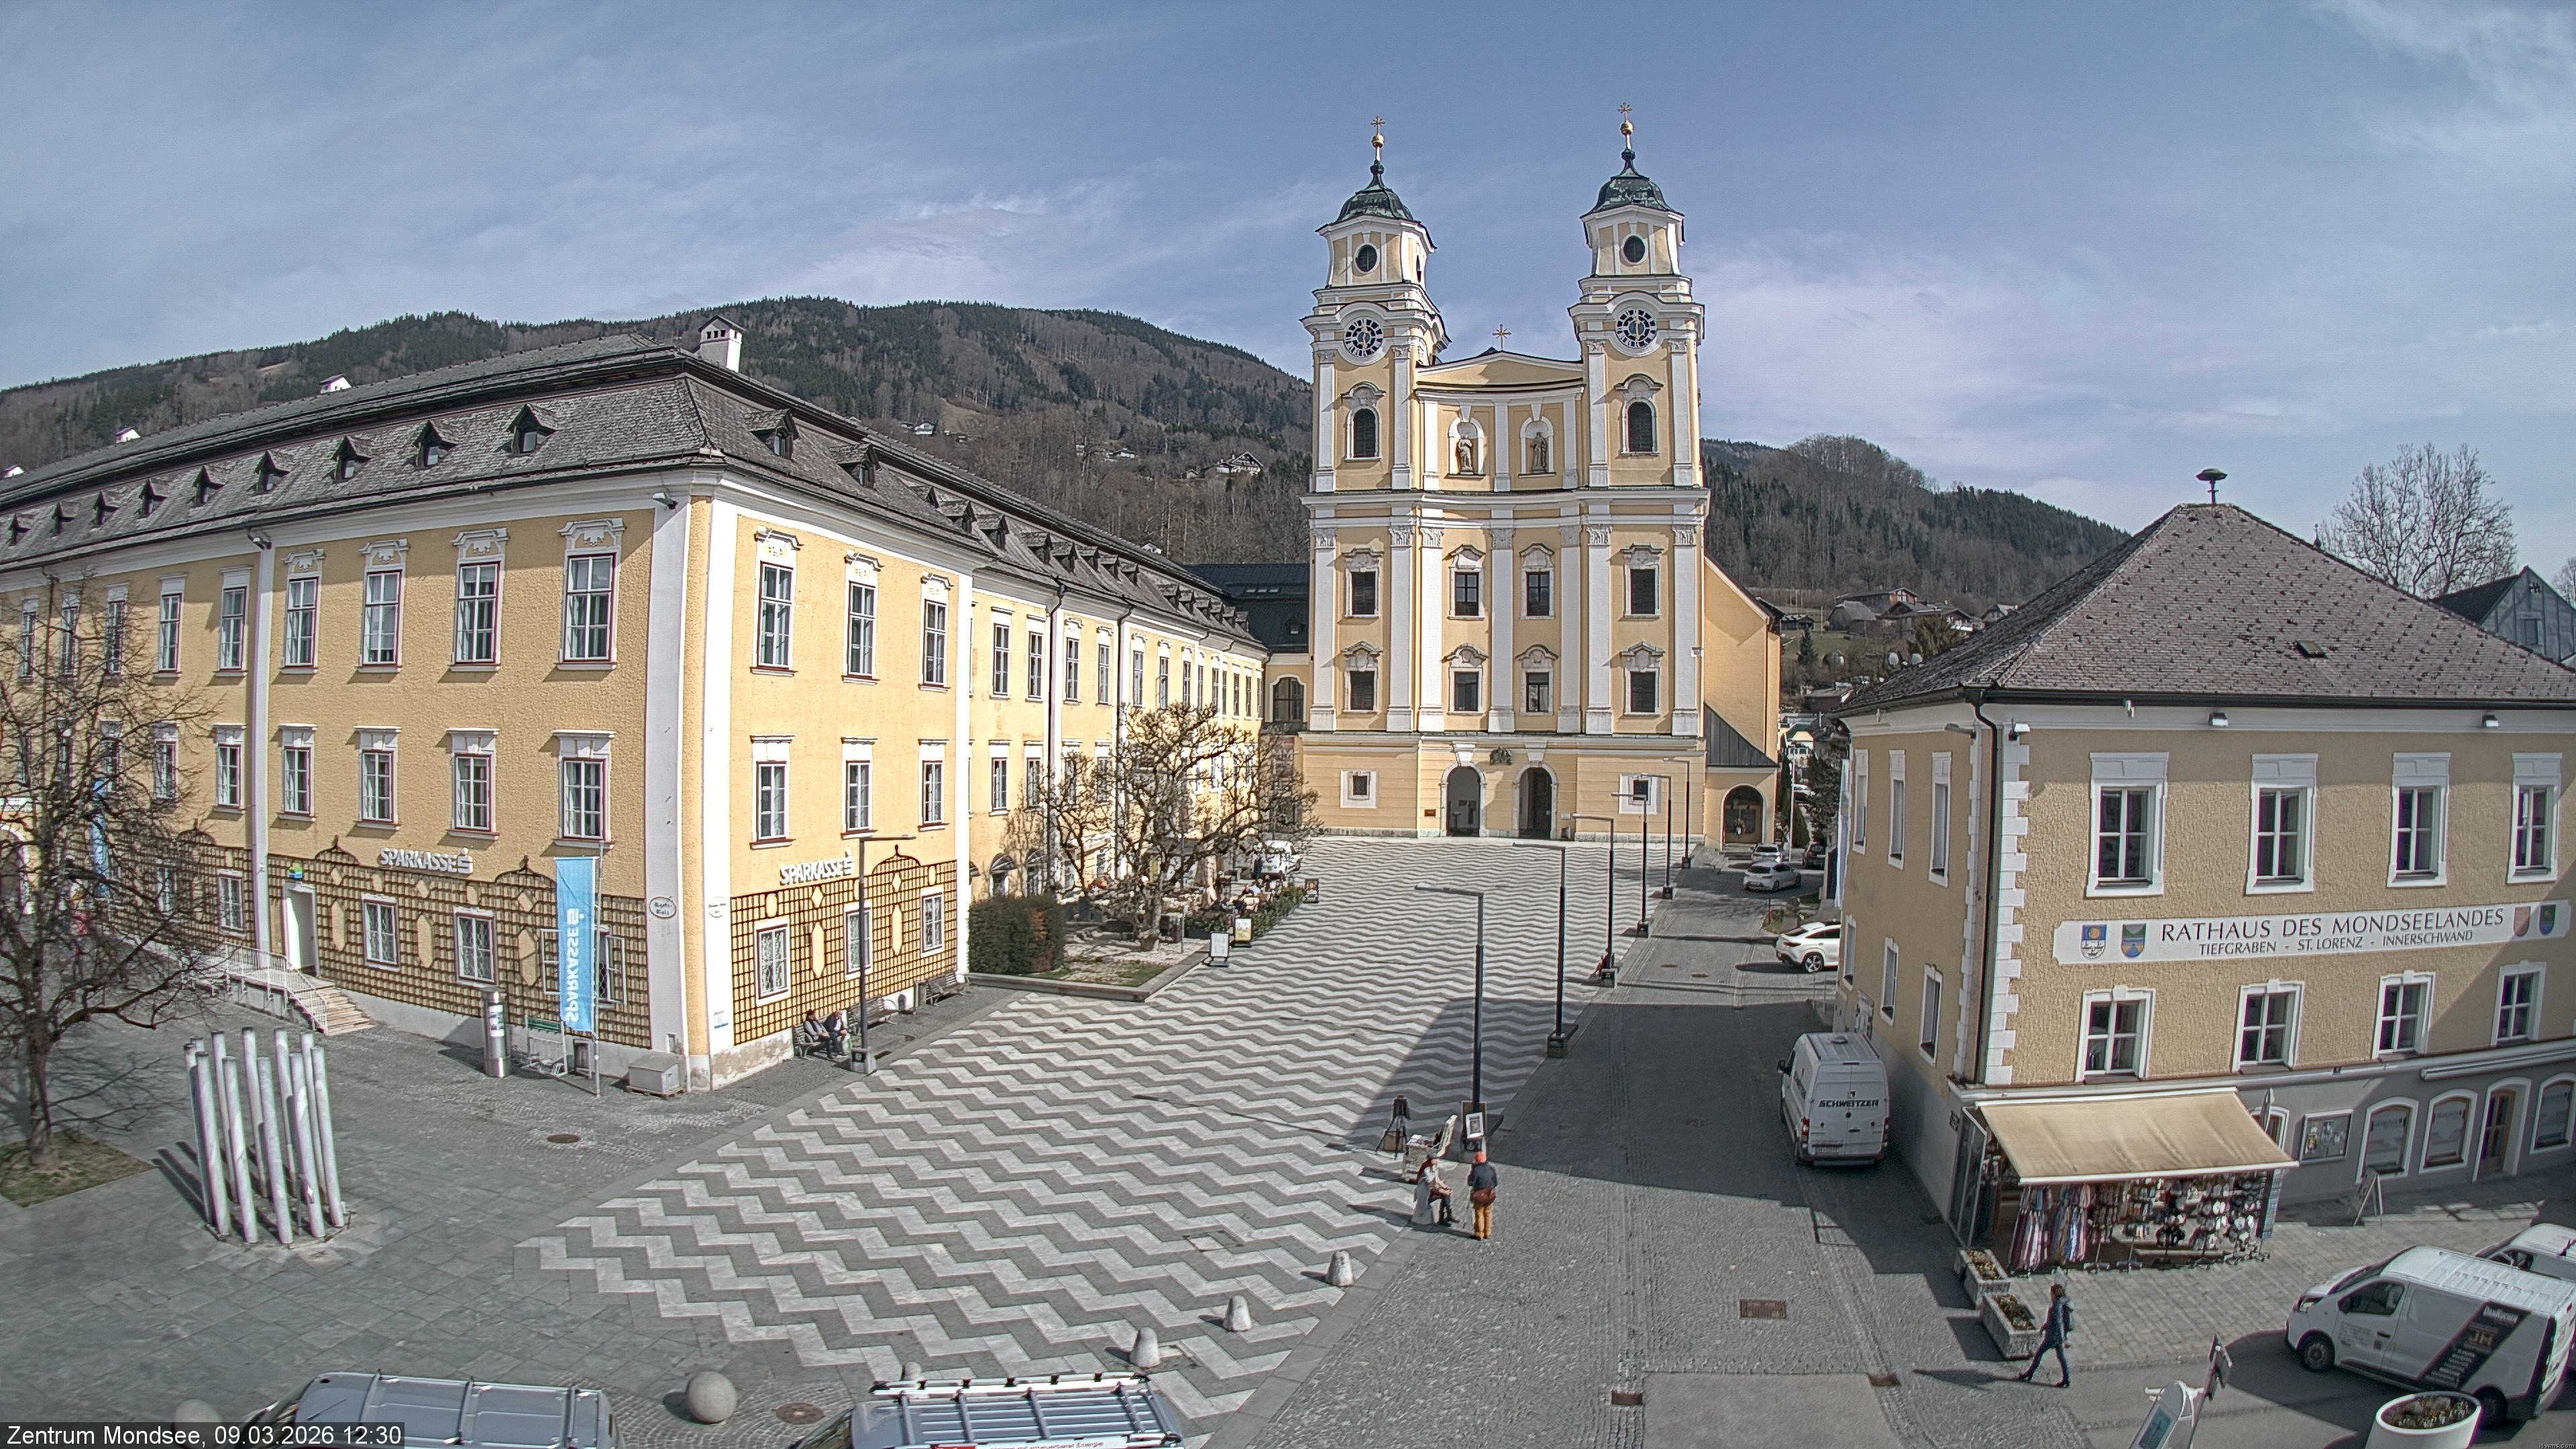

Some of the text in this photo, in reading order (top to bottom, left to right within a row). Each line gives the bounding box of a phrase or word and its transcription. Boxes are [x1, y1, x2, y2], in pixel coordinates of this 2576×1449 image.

[380, 847, 458, 873] SPARKASSE
[780, 858, 844, 884] SPARKASSE
[2161, 908, 2504, 942] RATHAUS DES MONDSEELANDES
[2199, 941, 2277, 955] TIEFGRABEN
[2297, 938, 2313, 951] ST.
[2316, 936, 2363, 950] LORENZ
[2383, 929, 2473, 947] INNERSCHWAND
[1818, 1099, 1879, 1108] SCHWEITZER
